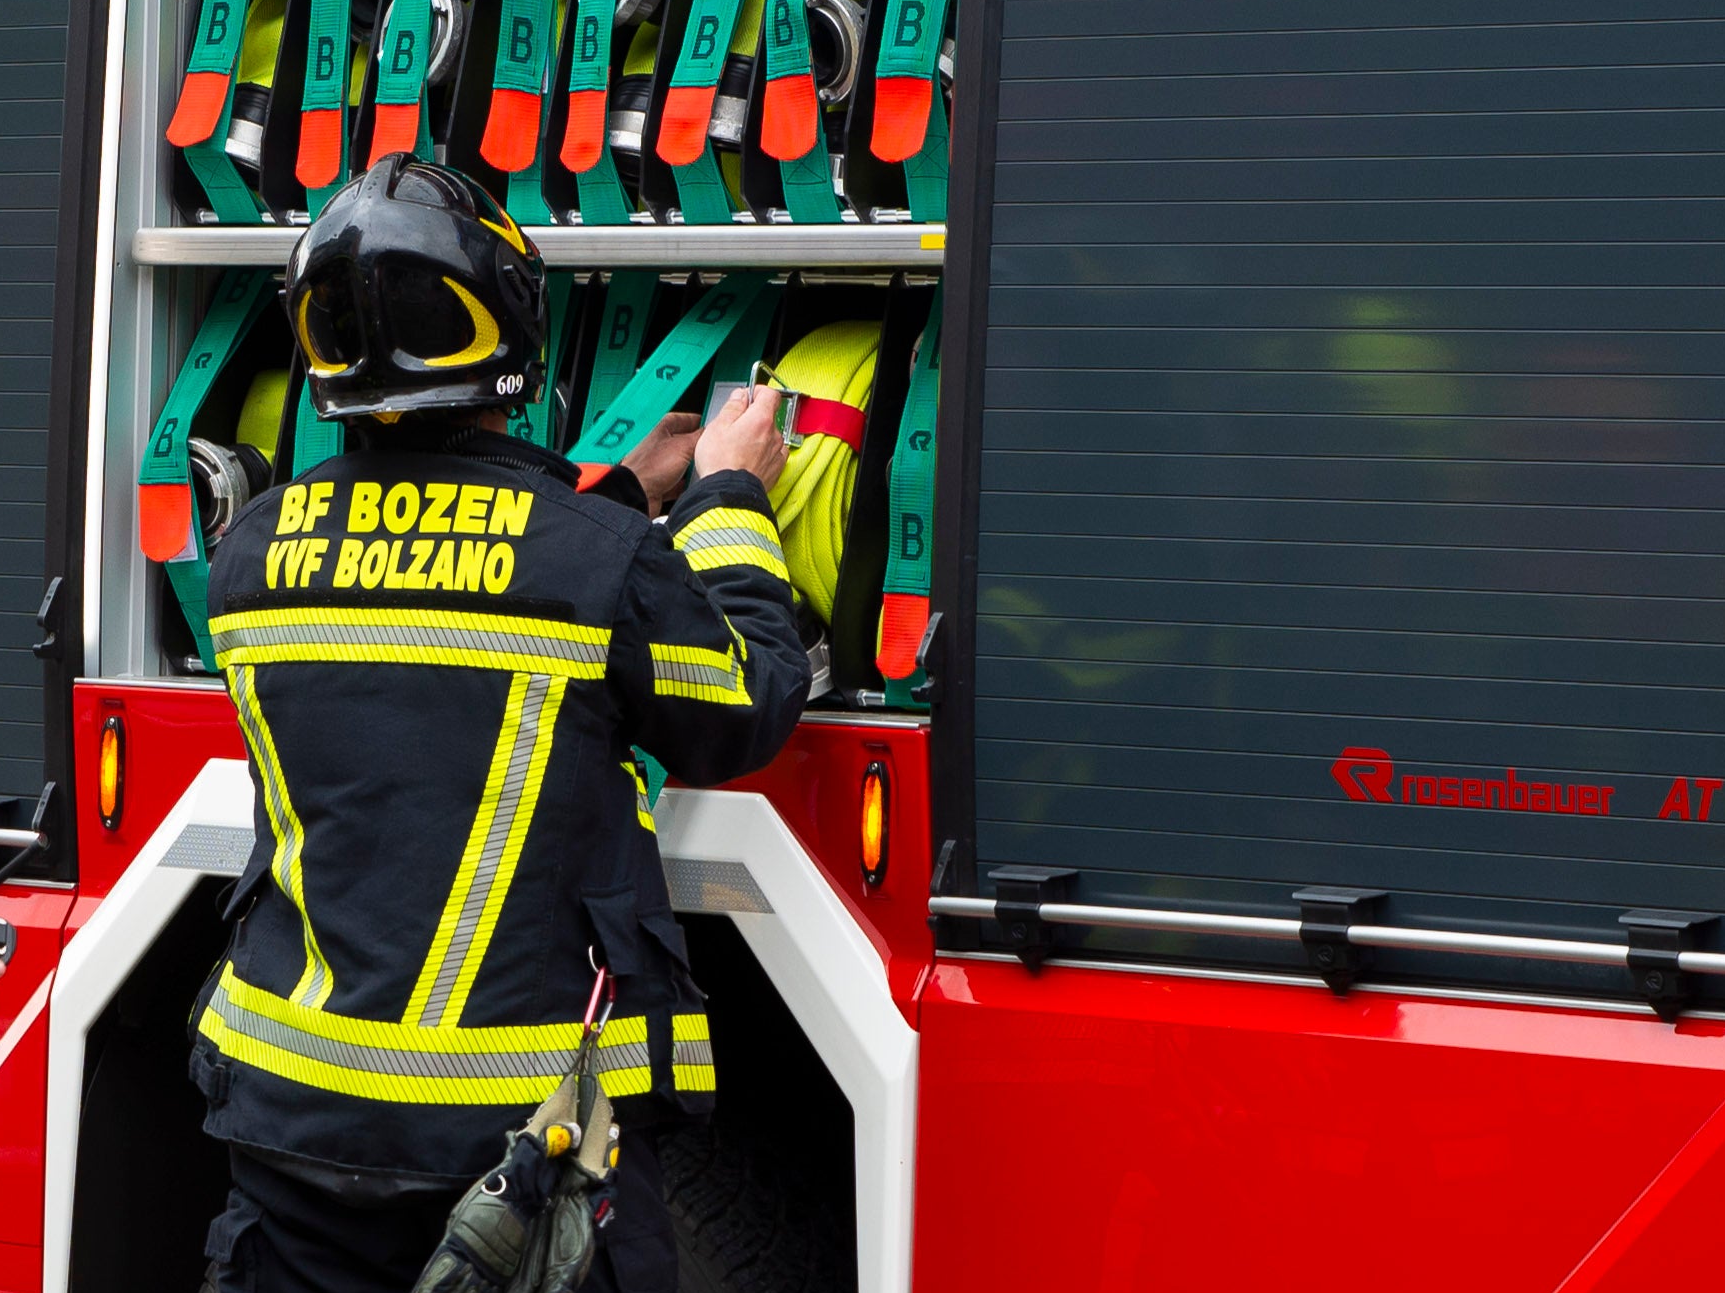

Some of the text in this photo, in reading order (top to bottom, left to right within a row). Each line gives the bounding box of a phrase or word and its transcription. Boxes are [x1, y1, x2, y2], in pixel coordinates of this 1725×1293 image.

[206, 2, 229, 45] B
[510, 18, 534, 63] B
[581, 16, 599, 62] B
[692, 16, 719, 59] B
[774, 0, 794, 46] B
[895, 1, 925, 47] B
[315, 36, 335, 80] B
[391, 30, 415, 74] B
[608, 305, 633, 350] B
[697, 293, 735, 324] B
[497, 374, 523, 395] 609
[153, 418, 178, 458] B
[595, 418, 635, 448] B
[277, 482, 534, 537] BF BOZEN
[901, 513, 924, 561] B
[266, 539, 515, 594] VVF BOLZANO
[1401, 768, 1615, 815] rosenbauer
[1658, 779, 1723, 822] AT
